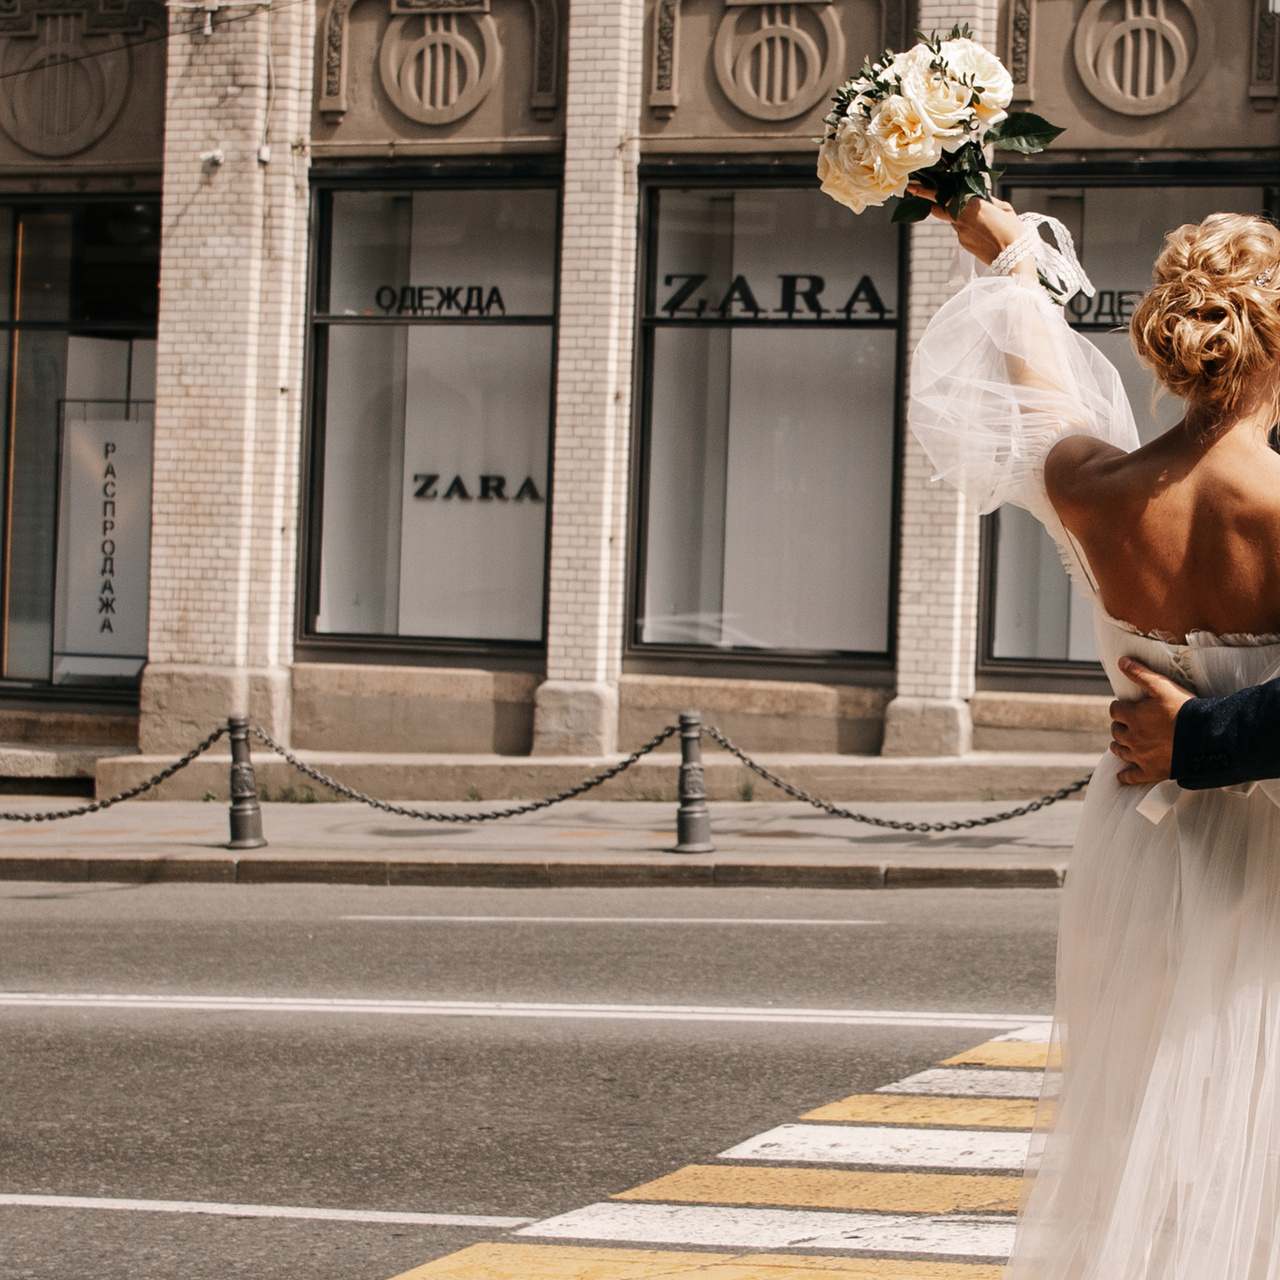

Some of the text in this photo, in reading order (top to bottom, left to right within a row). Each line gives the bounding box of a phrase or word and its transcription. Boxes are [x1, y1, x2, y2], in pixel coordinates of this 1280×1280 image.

[375, 285, 505, 315] ОДЕЖДА
[661, 273, 894, 318] ZARA
[1069, 290, 1144, 322] ОДЕ
[413, 474, 545, 502] ZARA
[98, 442, 116, 634] РАСПРОДАЖА
